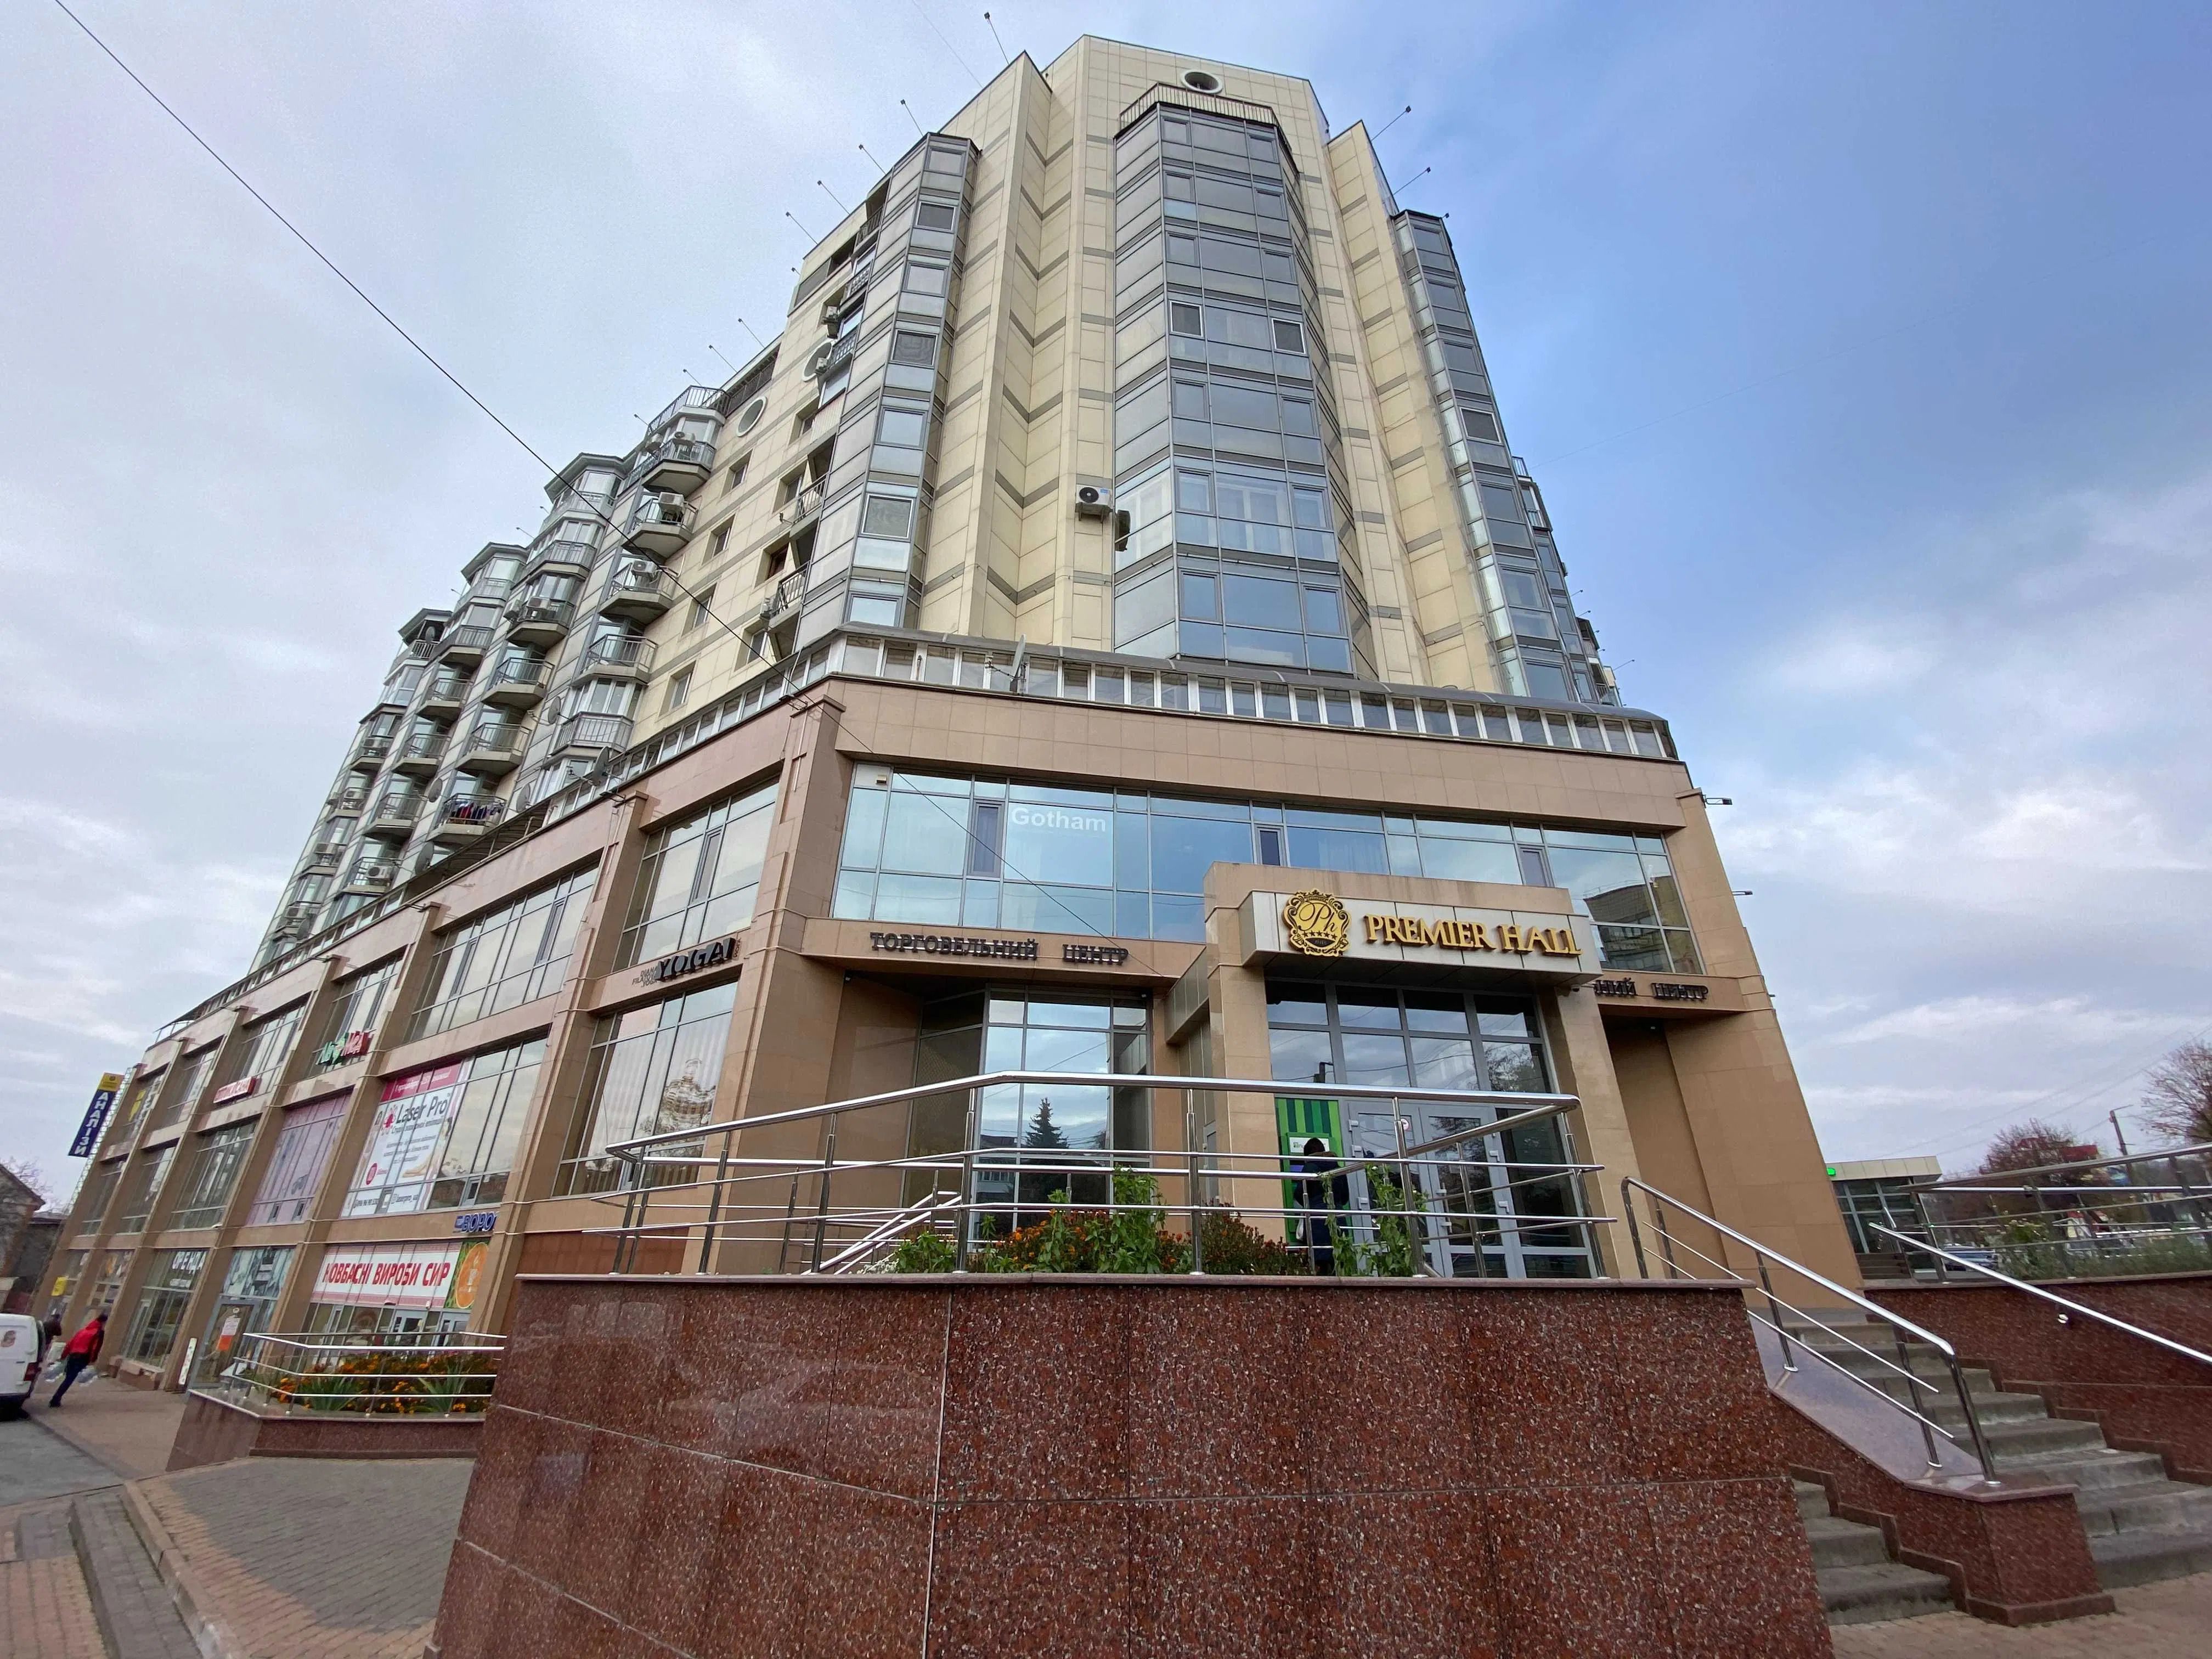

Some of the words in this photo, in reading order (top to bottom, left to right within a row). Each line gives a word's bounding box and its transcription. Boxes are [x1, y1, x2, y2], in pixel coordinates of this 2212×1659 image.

[1012, 807, 1106, 832] Gotham
[1364, 914, 1497, 951] PREMIER
[1497, 924, 1584, 957] HALL
[870, 932, 1039, 961] ТОРГОВЕЛЬНИЙ
[1062, 944, 1129, 966] ЦЕНТР
[1652, 983, 1708, 1001] ЦЕНТР
[396, 1104, 427, 1124] Laser
[427, 1096, 448, 1117] Pro
[74, 1092, 108, 1155] АНАЛІЗИ
[172, 1250, 207, 1274] ОРЕНДА
[371, 1263, 421, 1286] ВИРОБИ
[422, 1263, 451, 1286] СИР
